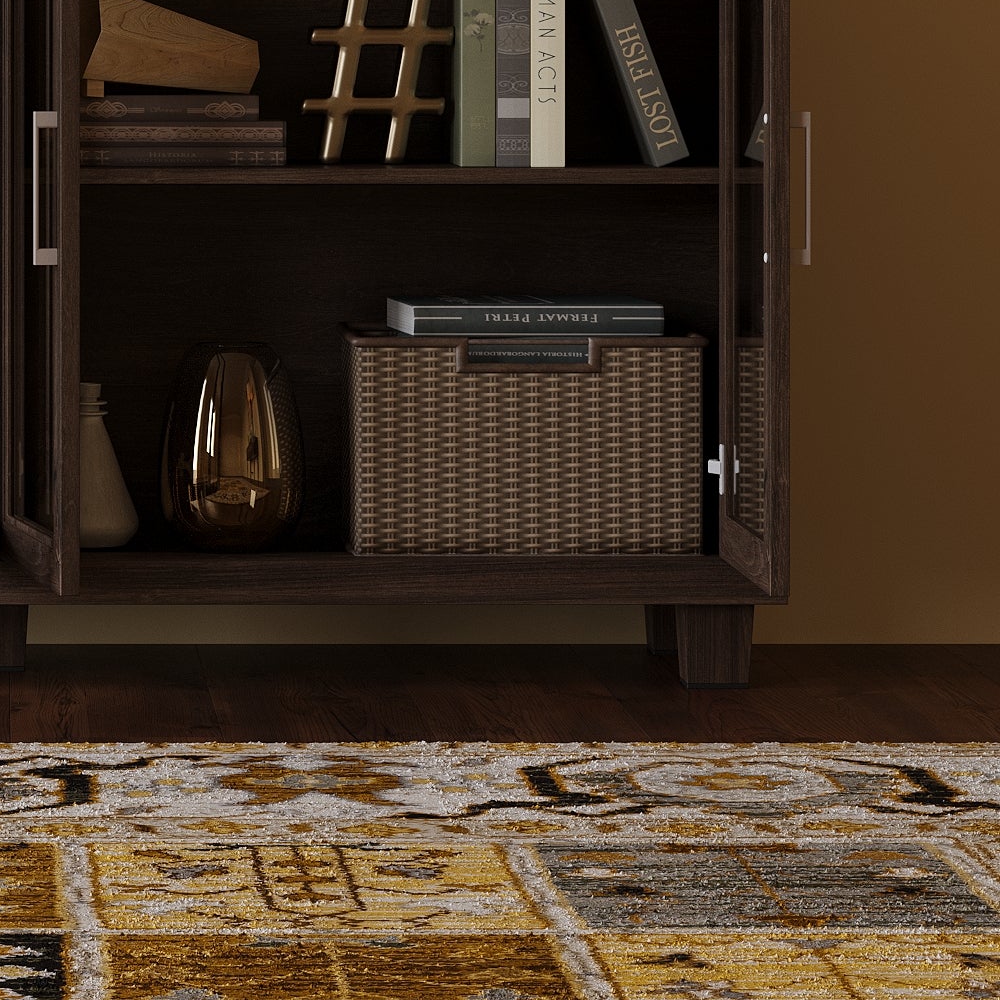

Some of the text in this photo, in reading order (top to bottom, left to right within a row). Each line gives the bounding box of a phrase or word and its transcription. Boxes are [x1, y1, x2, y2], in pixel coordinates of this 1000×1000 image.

[538, 50, 556, 104] ACTS
[614, 22, 679, 151] LOST FISH
[484, 313, 598, 323] FERMAT PETRI
